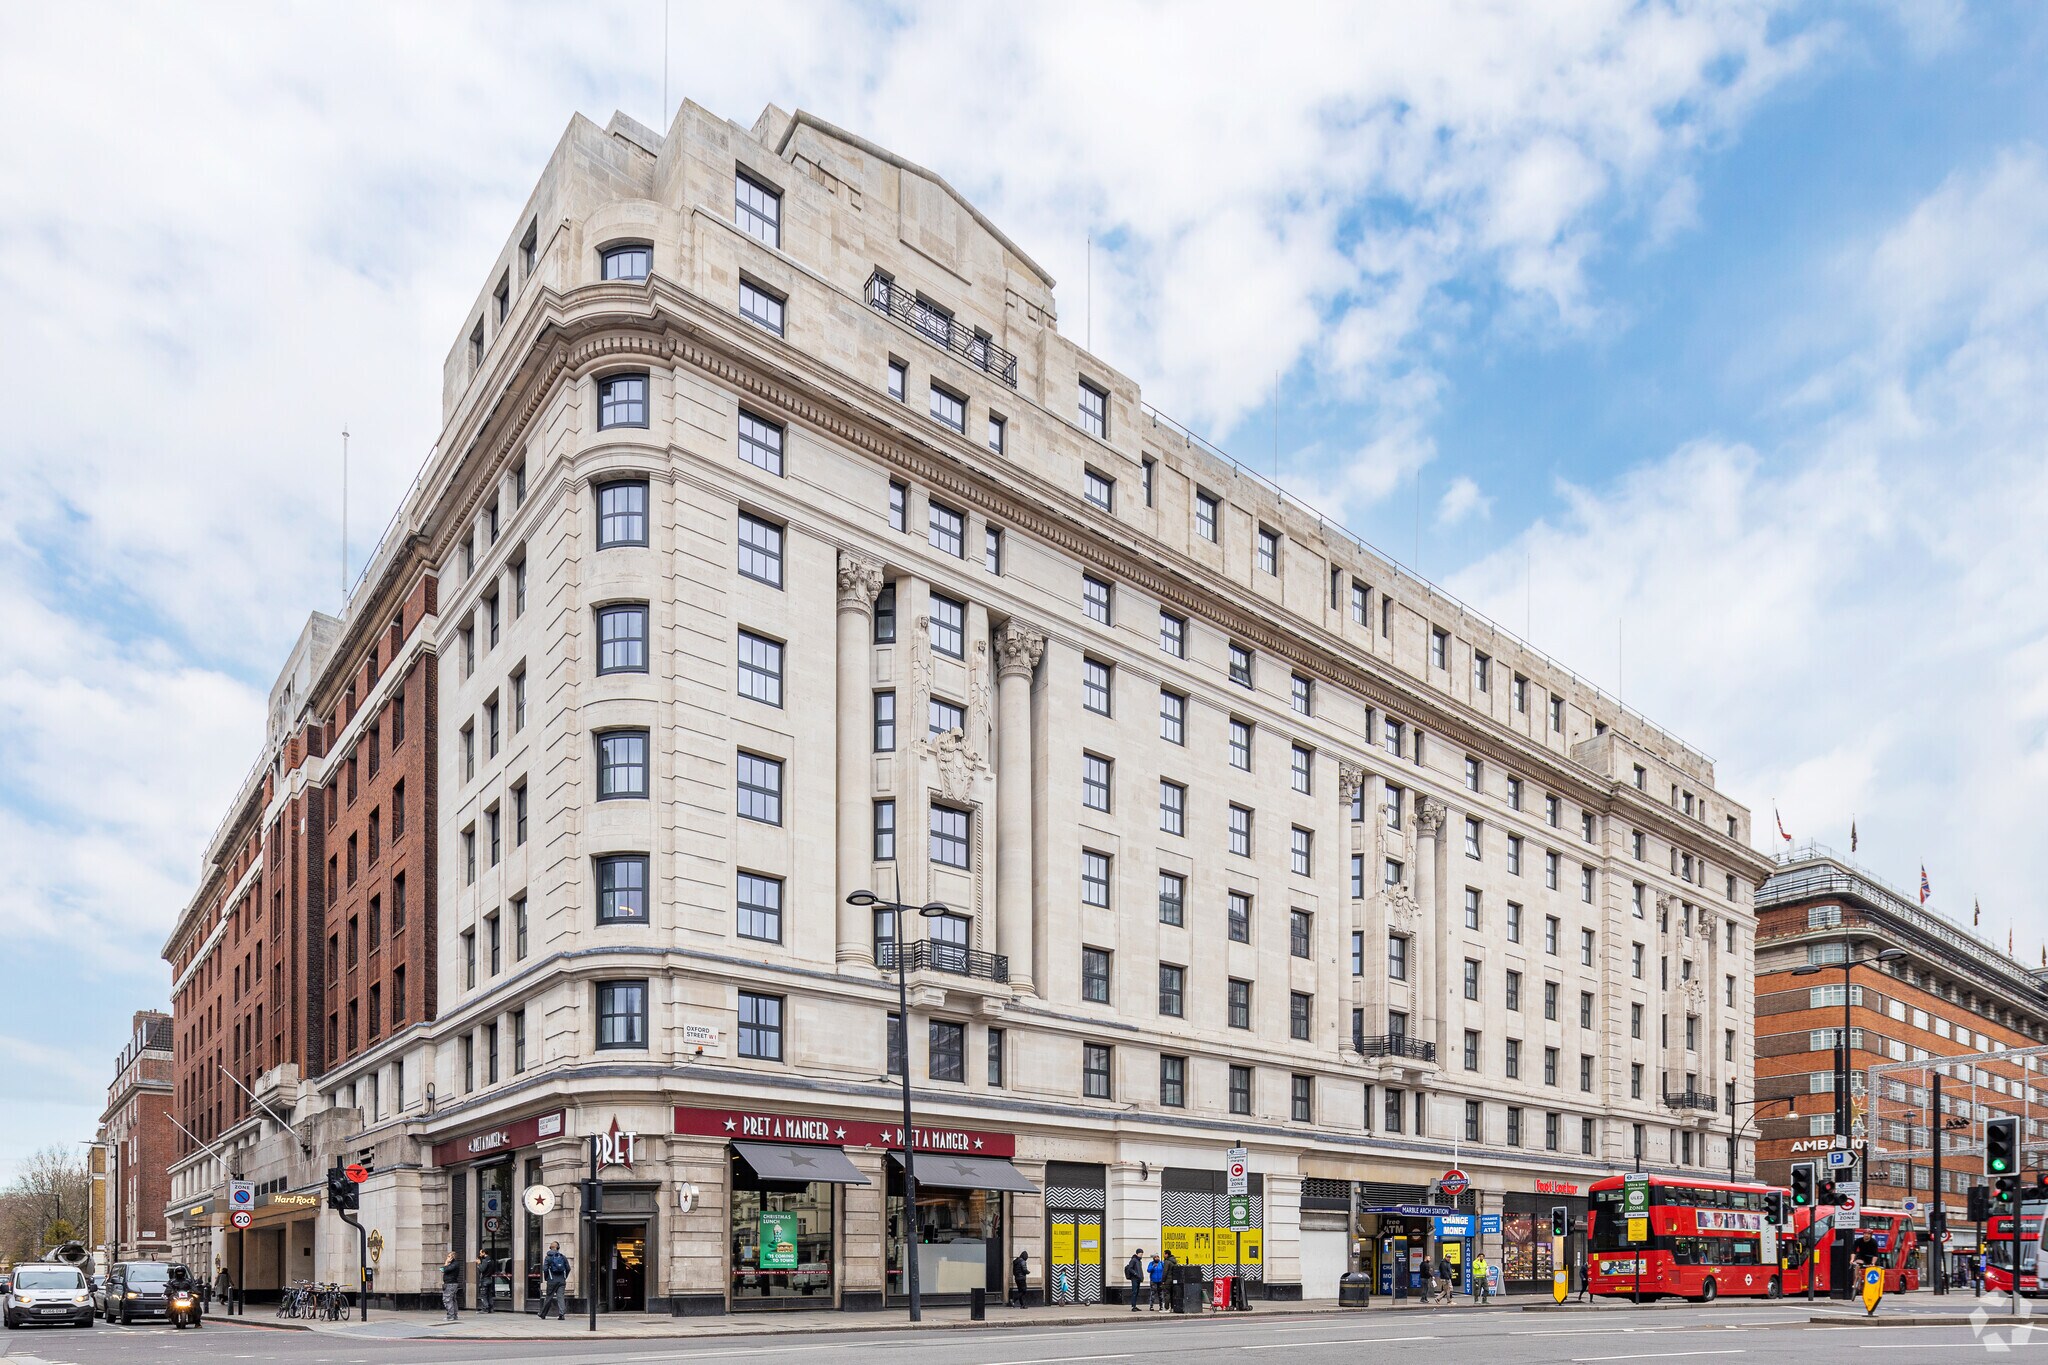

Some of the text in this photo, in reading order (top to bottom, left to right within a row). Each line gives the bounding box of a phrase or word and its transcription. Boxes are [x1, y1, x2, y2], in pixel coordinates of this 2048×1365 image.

[686, 1025, 710, 1034] OXFORD
[686, 1031, 708, 1039] STREET
[743, 1115, 829, 1140] PRET A MANGER
[896, 1128, 969, 1150] PT A MANGER
[1833, 1154, 1842, 1163] P
[1535, 1179, 1578, 1195] Foot Locker
[274, 1194, 316, 1206] Hard Rock
[235, 1215, 250, 1224] 20
[1441, 1216, 1468, 1225] CHANGE
[1384, 1225, 1404, 1234] ATM
[1443, 1226, 1467, 1235] MONEY
[1164, 1232, 1187, 1241] LANDMARK
[1164, 1241, 1189, 1250] YOUR BRAND
